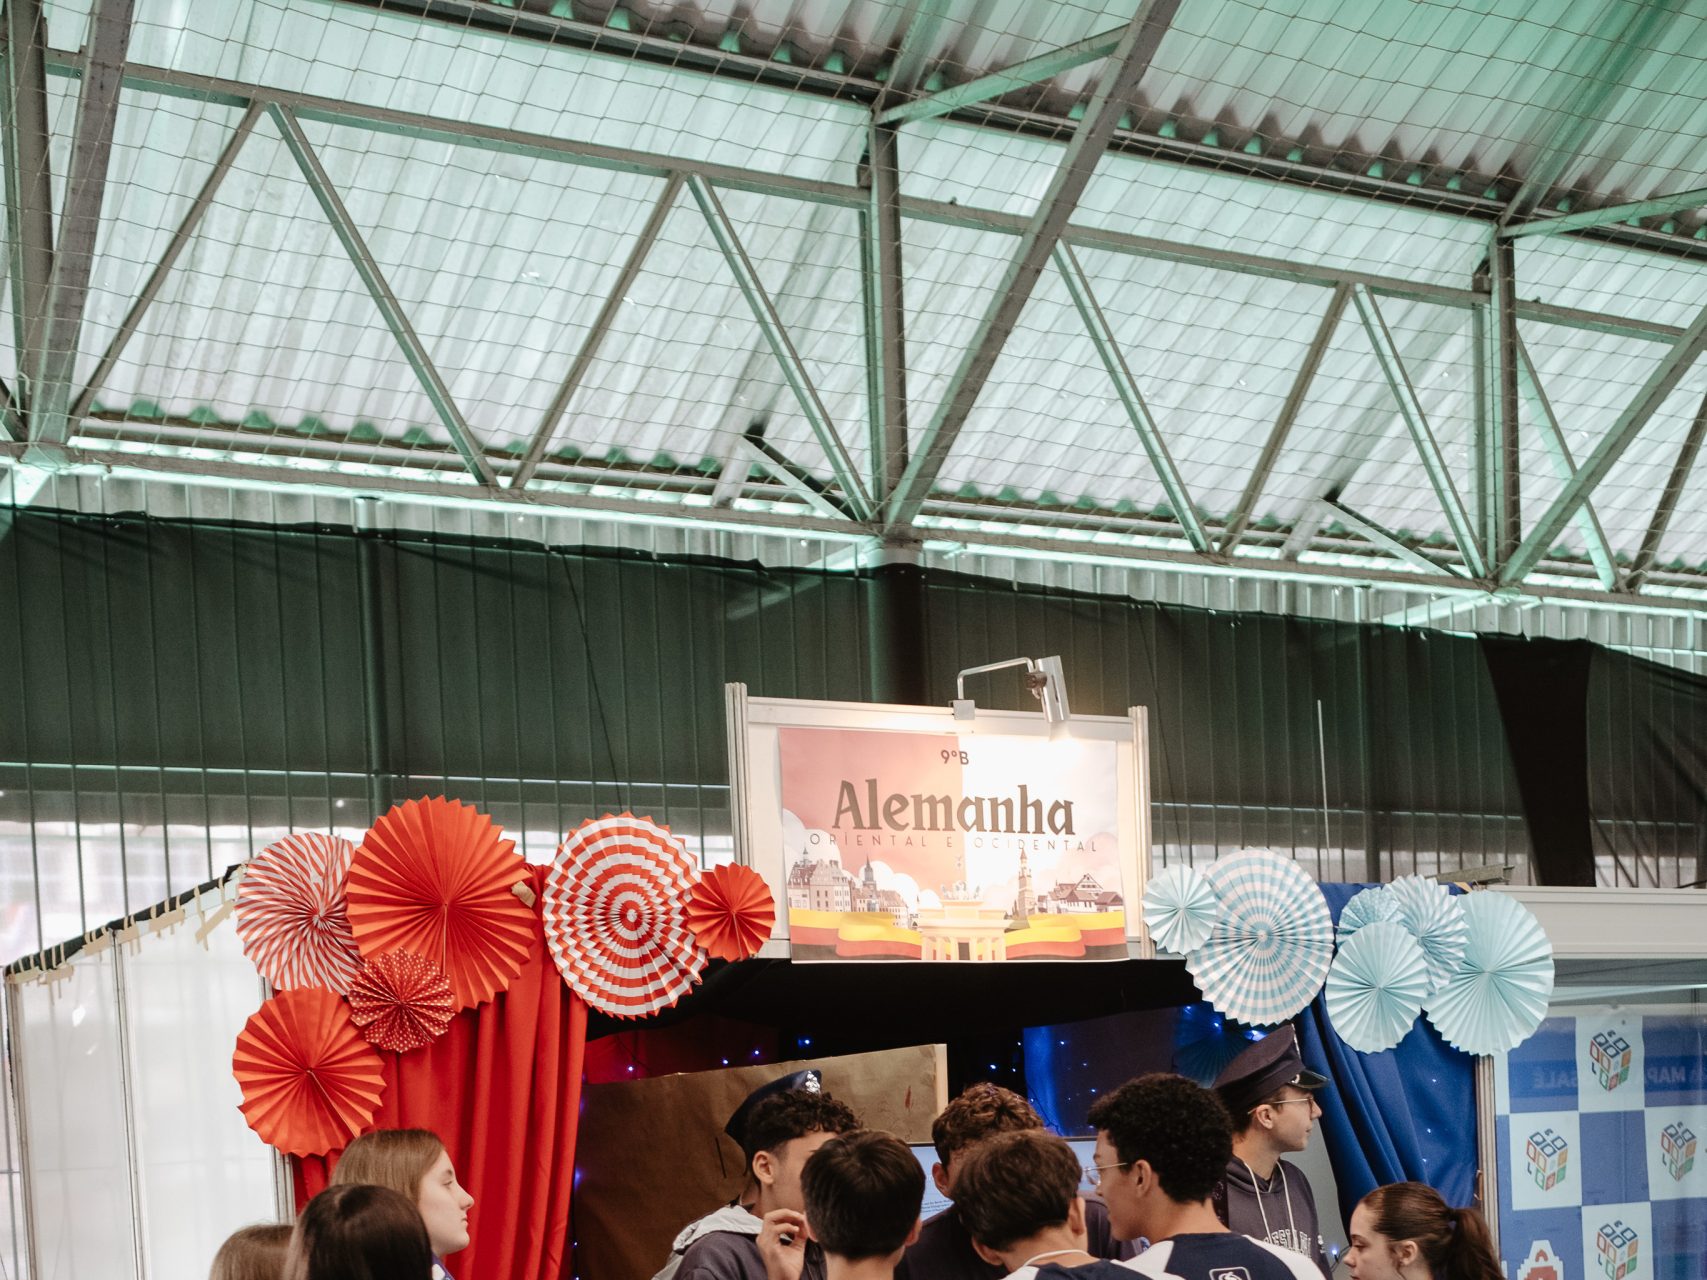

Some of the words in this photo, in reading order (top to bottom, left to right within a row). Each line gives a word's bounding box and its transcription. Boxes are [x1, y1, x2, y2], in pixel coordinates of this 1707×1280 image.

[832, 778, 1076, 836] Alemanha
[809, 831, 927, 847] ORIENTAL
[946, 837, 953, 848] E
[974, 836, 1097, 852] OCIDENTAL
